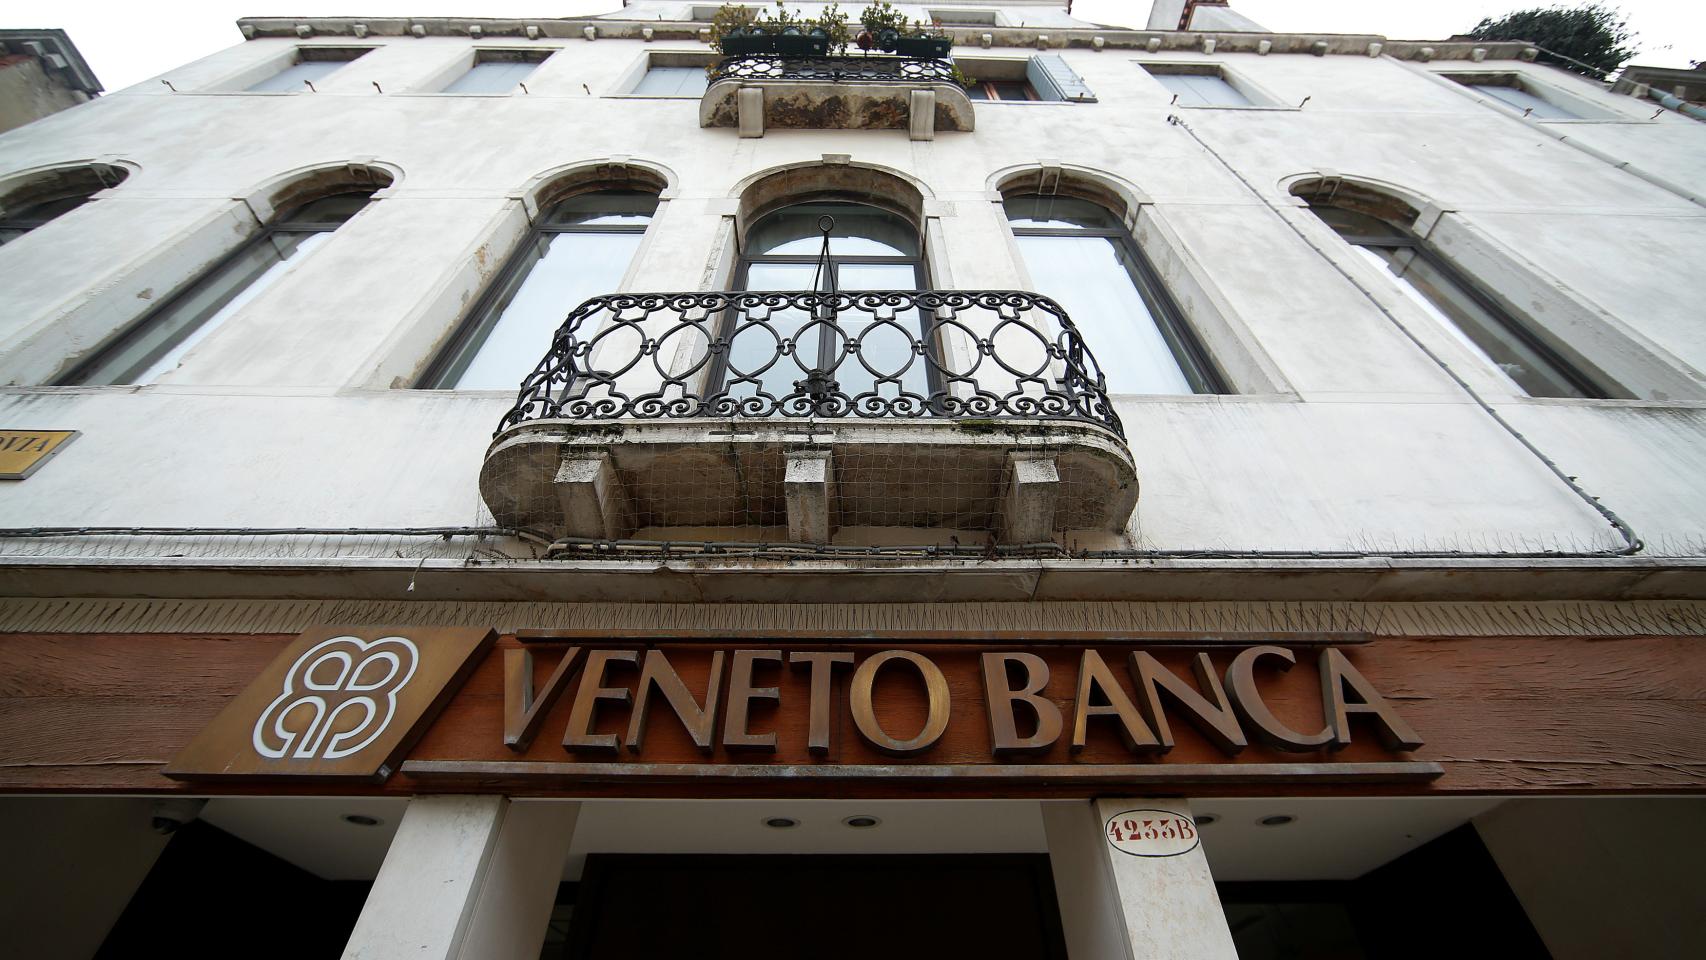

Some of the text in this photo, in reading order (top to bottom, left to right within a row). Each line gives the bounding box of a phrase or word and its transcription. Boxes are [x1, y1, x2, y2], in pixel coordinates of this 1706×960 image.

[503, 645, 1425, 757] VENETO BANCA
[1109, 819, 1195, 841] 4233B
